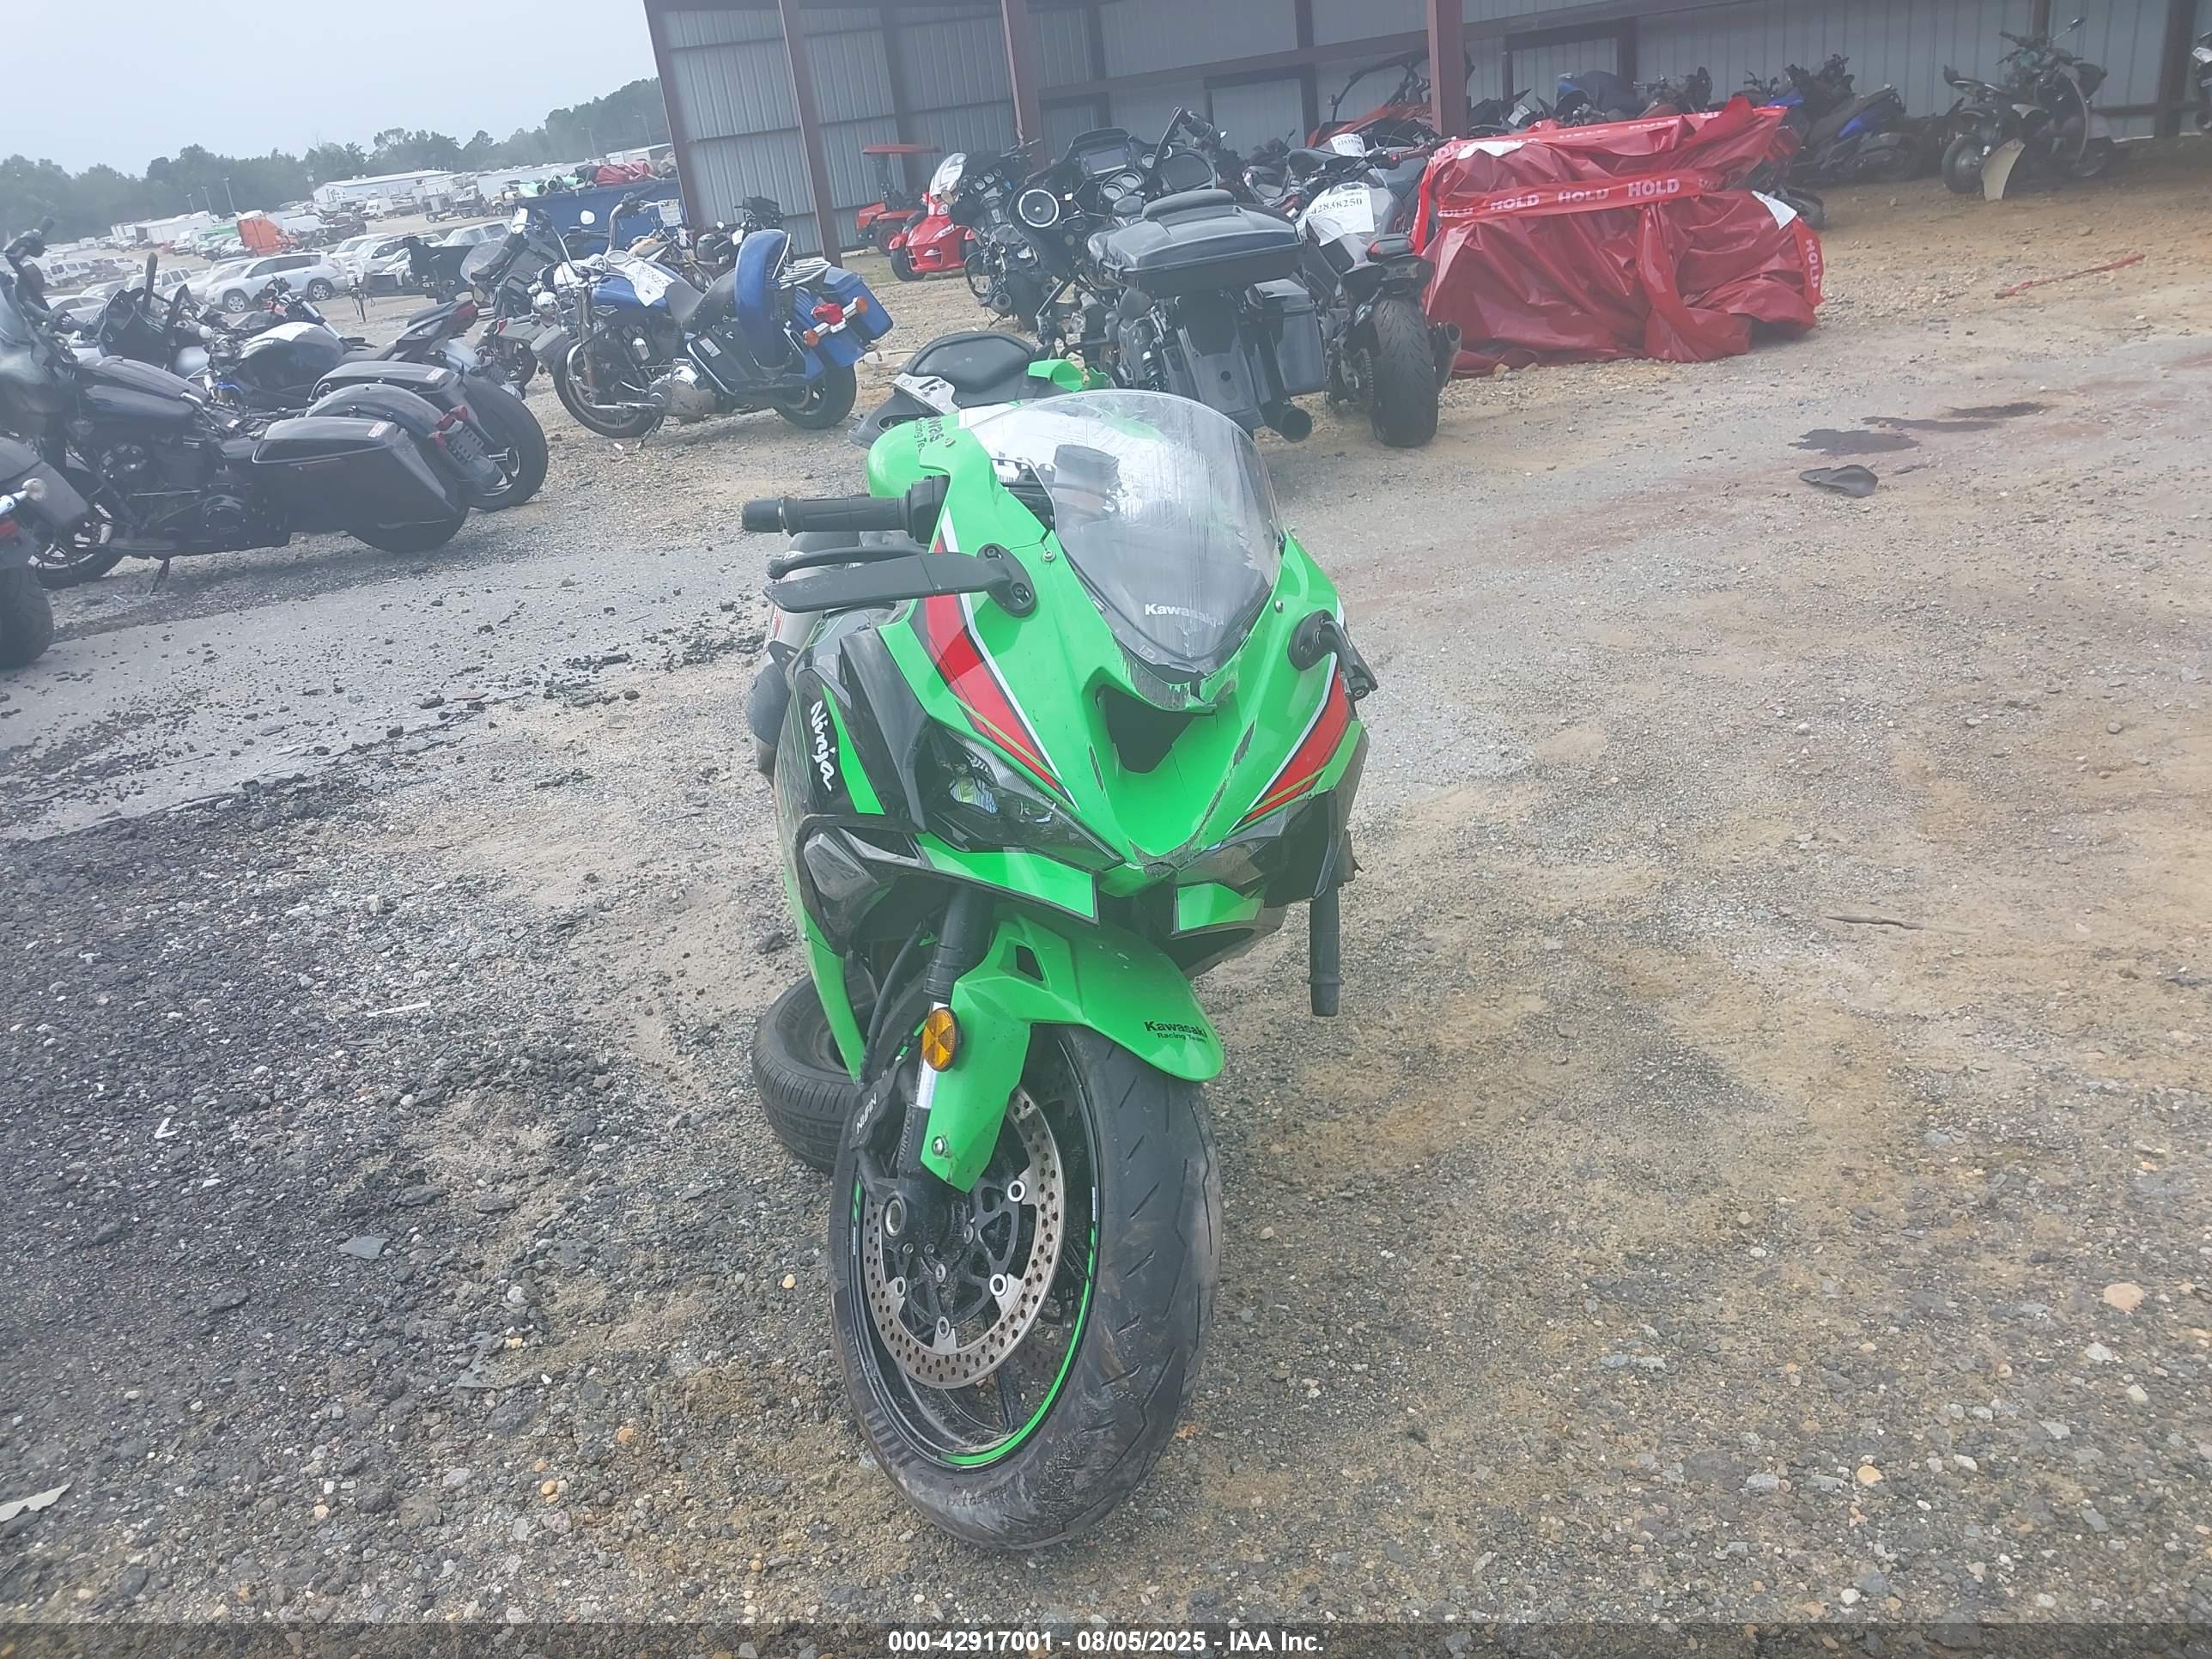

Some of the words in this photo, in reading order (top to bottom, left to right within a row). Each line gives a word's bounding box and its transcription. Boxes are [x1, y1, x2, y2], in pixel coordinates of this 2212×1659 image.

[1558, 187, 1609, 204] HOLD
[1627, 179, 1680, 198] HOLD
[1806, 239, 1820, 289] HOLD
[810, 700, 836, 792] Ninja
[1144, 1020, 1208, 1038] Kawasaki
